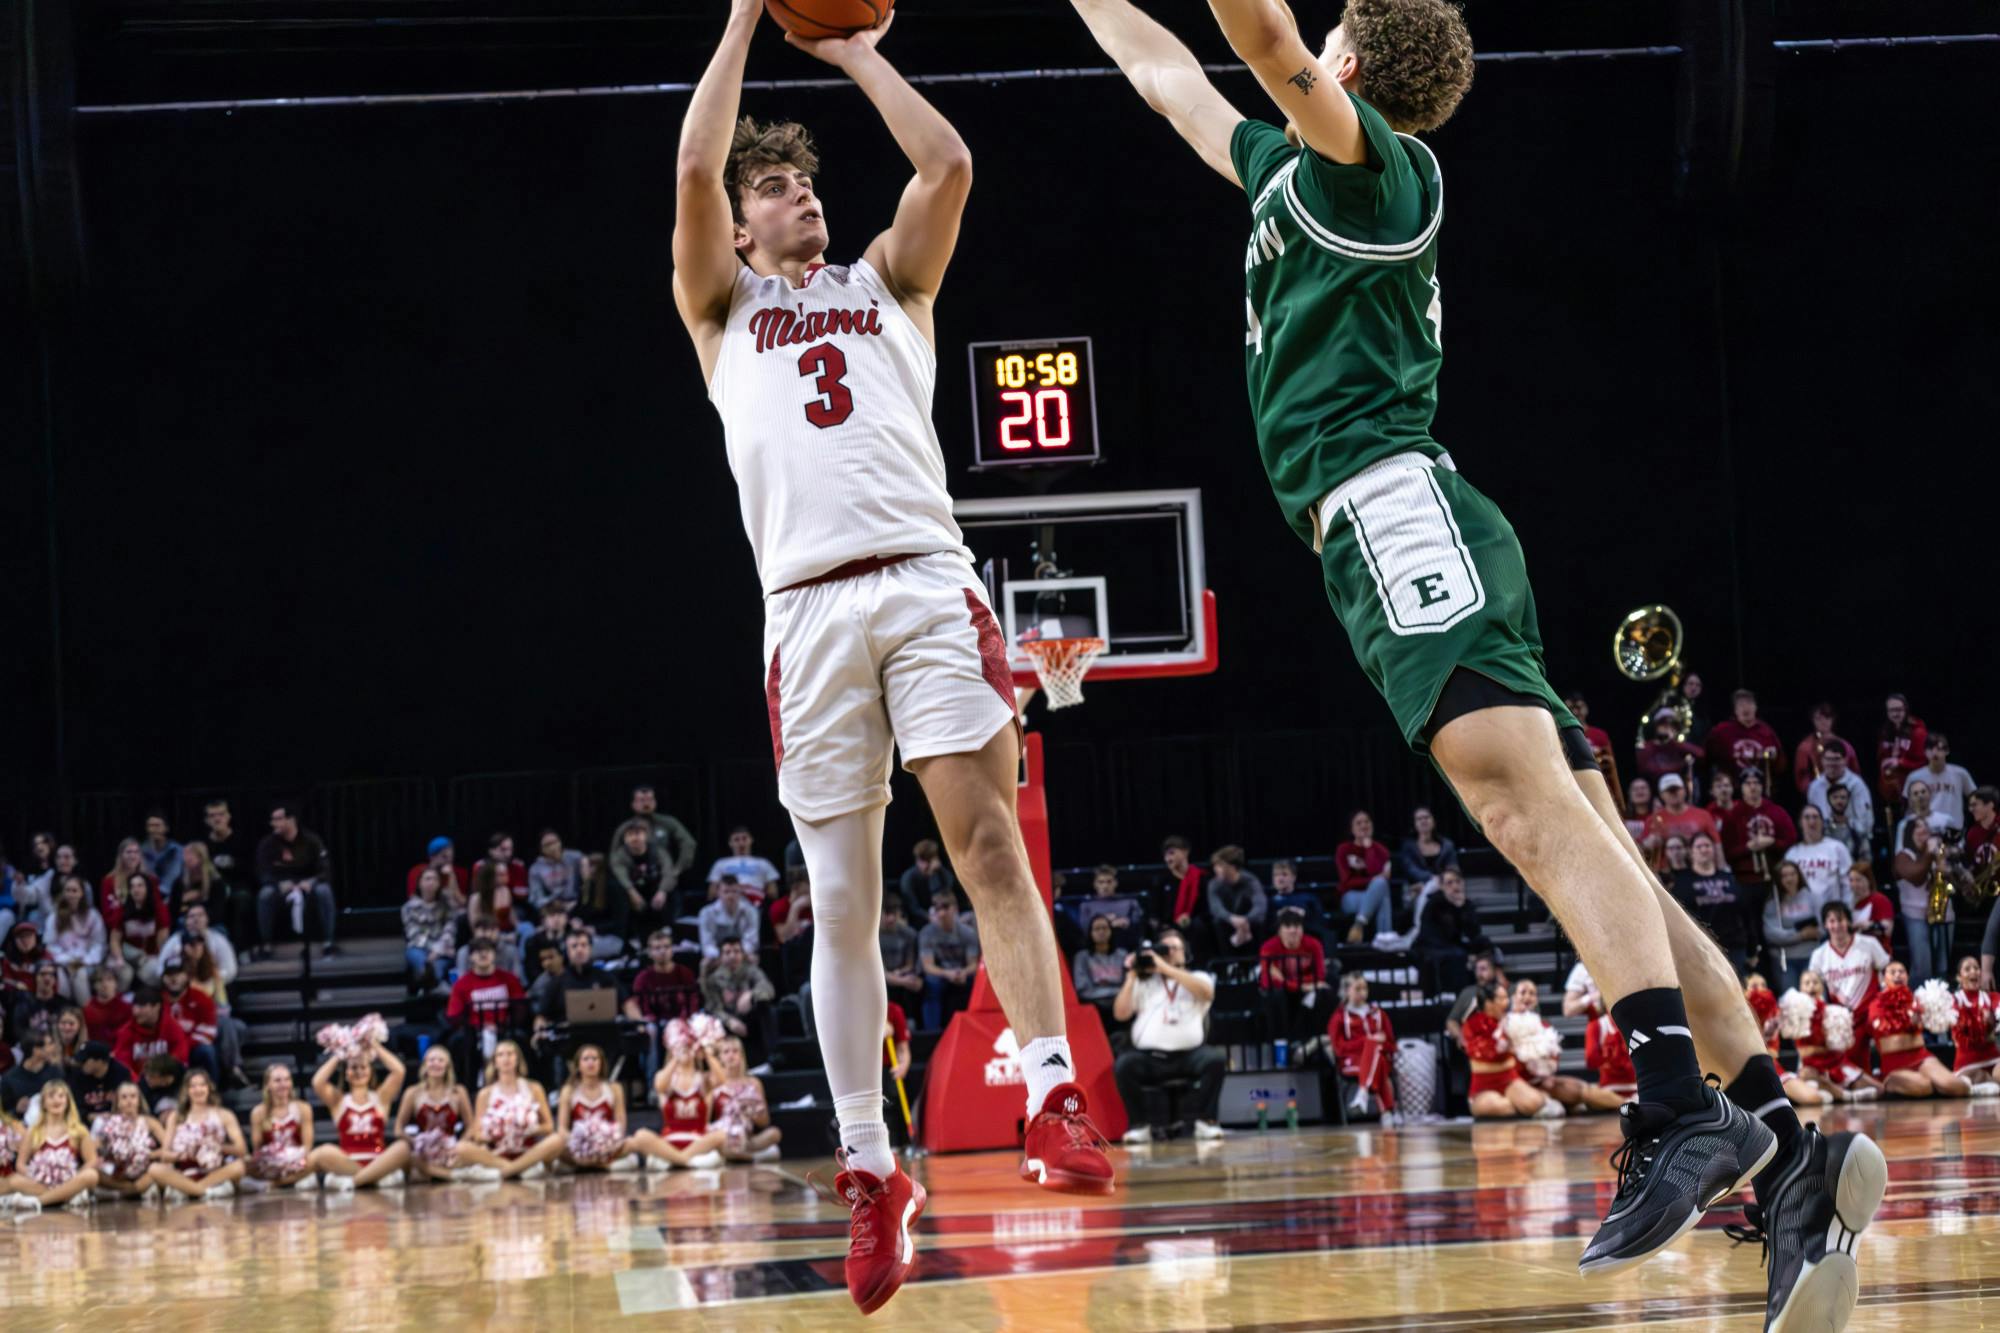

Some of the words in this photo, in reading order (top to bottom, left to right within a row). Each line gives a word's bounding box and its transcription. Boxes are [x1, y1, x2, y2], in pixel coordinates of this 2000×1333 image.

[748, 298, 883, 354] Miami
[797, 341, 855, 430] 3
[995, 351, 1079, 389] 10:58
[1000, 388, 1071, 450] 20
[1410, 571, 1451, 610] E
